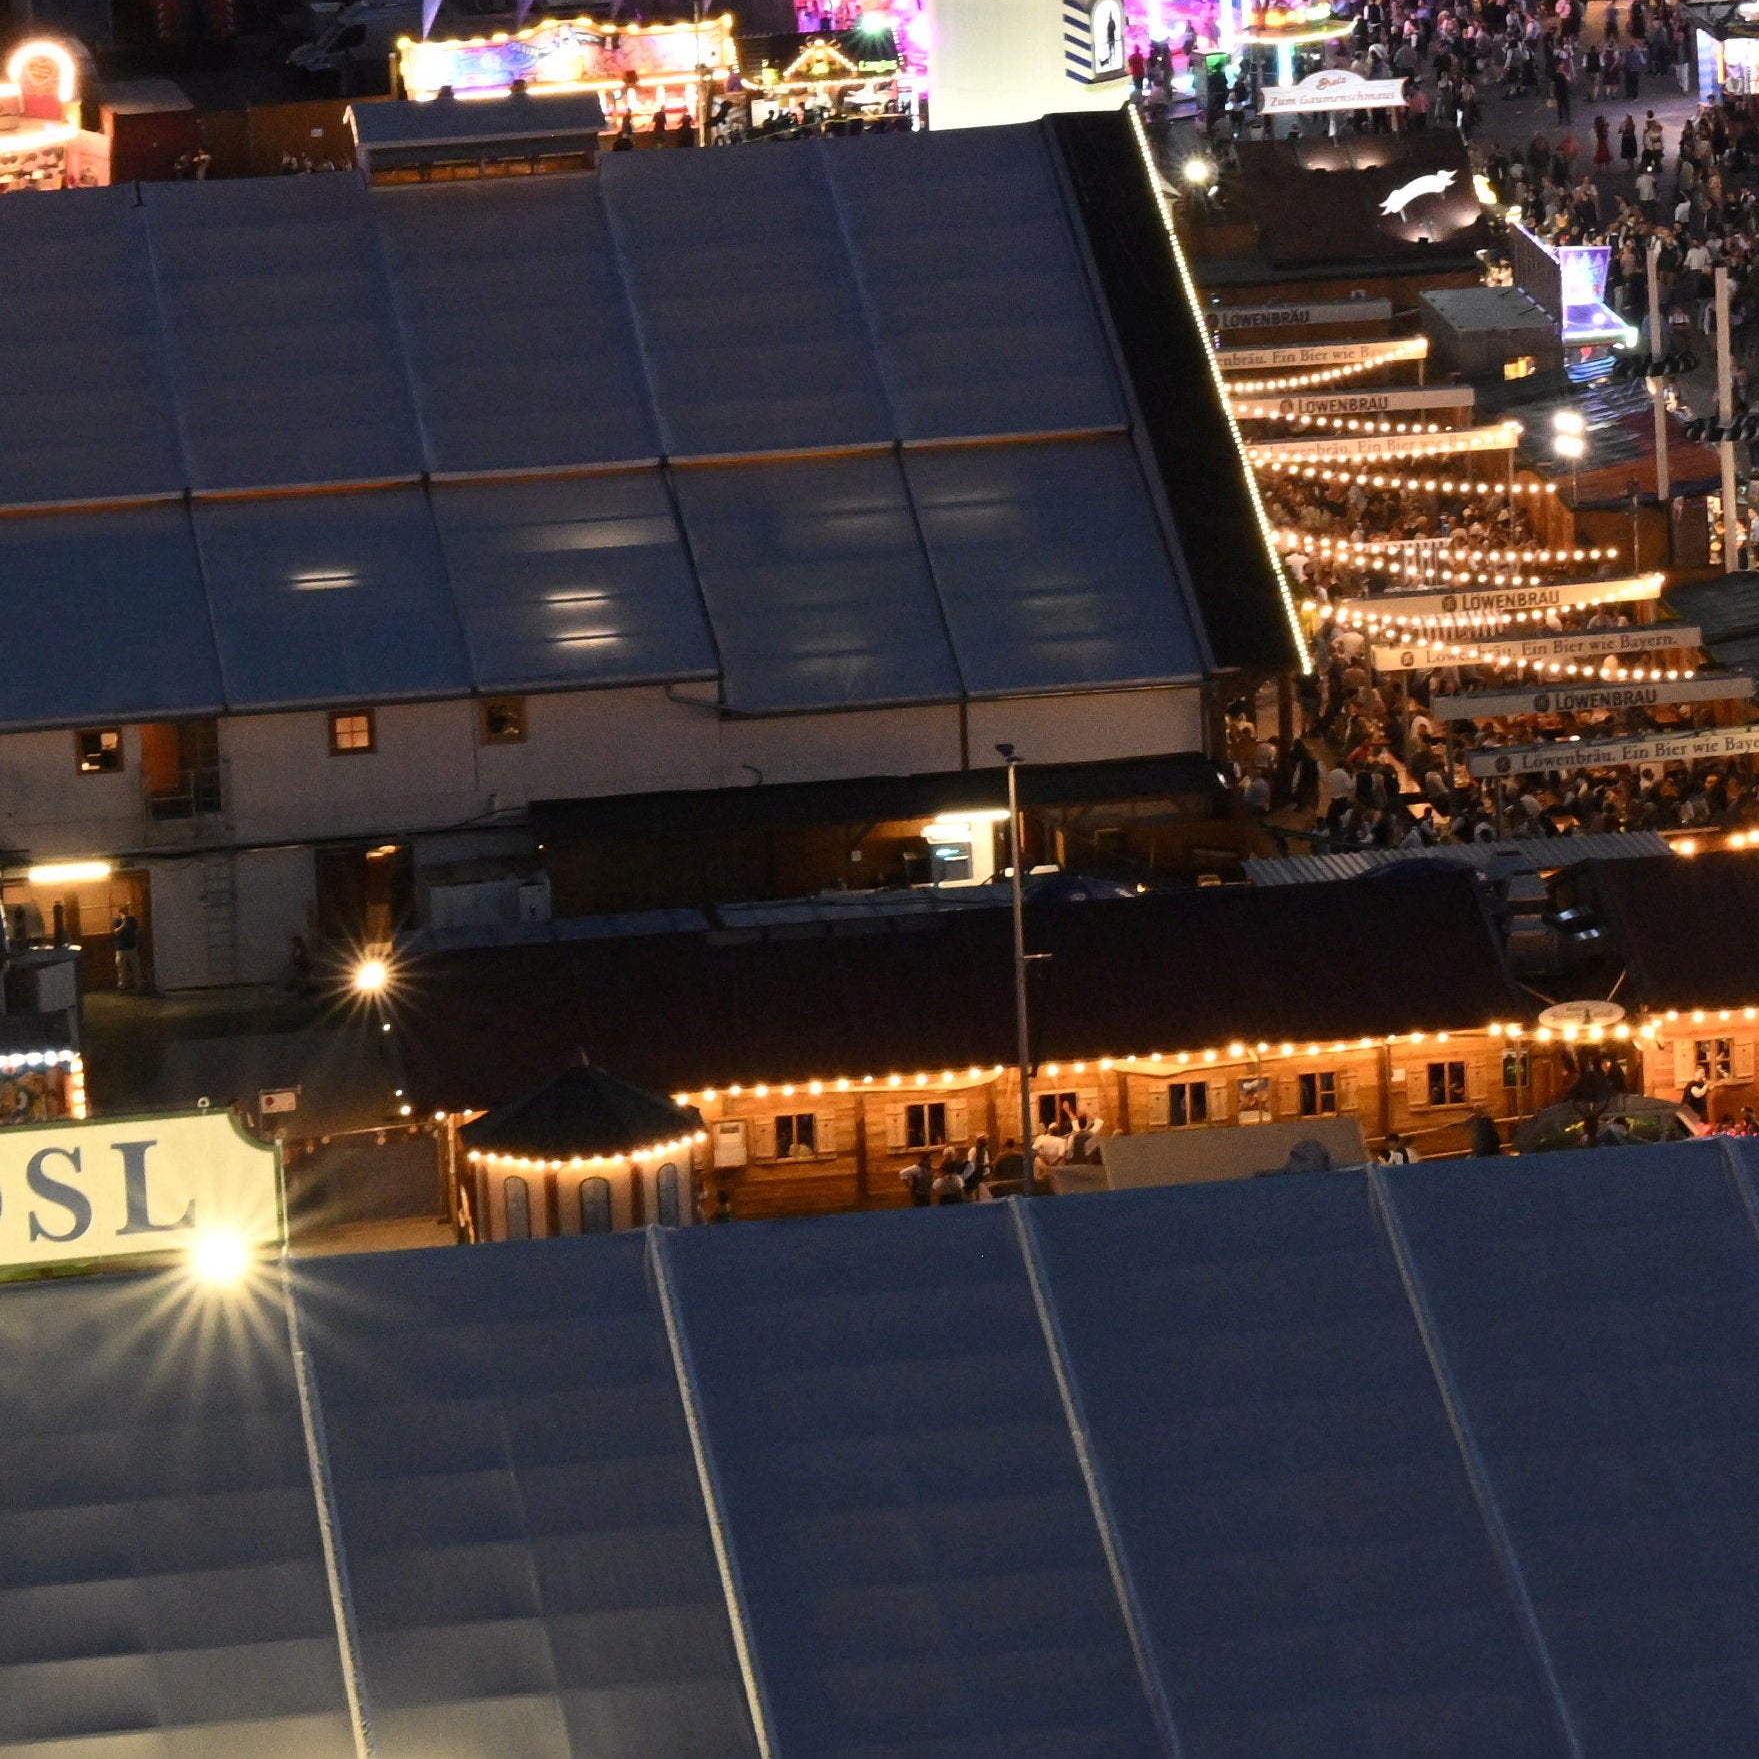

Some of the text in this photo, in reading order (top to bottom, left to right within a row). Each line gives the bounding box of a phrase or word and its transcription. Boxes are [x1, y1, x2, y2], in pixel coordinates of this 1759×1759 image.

[1270, 91, 1395, 107] Zum Gaumenschmaus
[1222, 309, 1310, 328] LÖWENBRÄU
[1272, 347, 1297, 365] Ein
[1300, 345, 1329, 363] Bier
[1332, 344, 1355, 360] wie
[1298, 395, 1389, 415] LÖWENBRÄU
[1461, 589, 1560, 612] LÖWENBRÄU
[1521, 643, 1548, 657] Ein
[1552, 638, 1587, 655] Bier
[1589, 639, 1615, 651] wie
[1620, 632, 1678, 653] Bayern.
[1554, 688, 1658, 711] LÖWENBRÄU
[1521, 749, 1617, 769] Löwenbräu.
[1622, 744, 1650, 760] Ein
[1654, 740, 1688, 758] Bier
[1692, 737, 1719, 754] wie
[0, 1138, 197, 1243] SL
